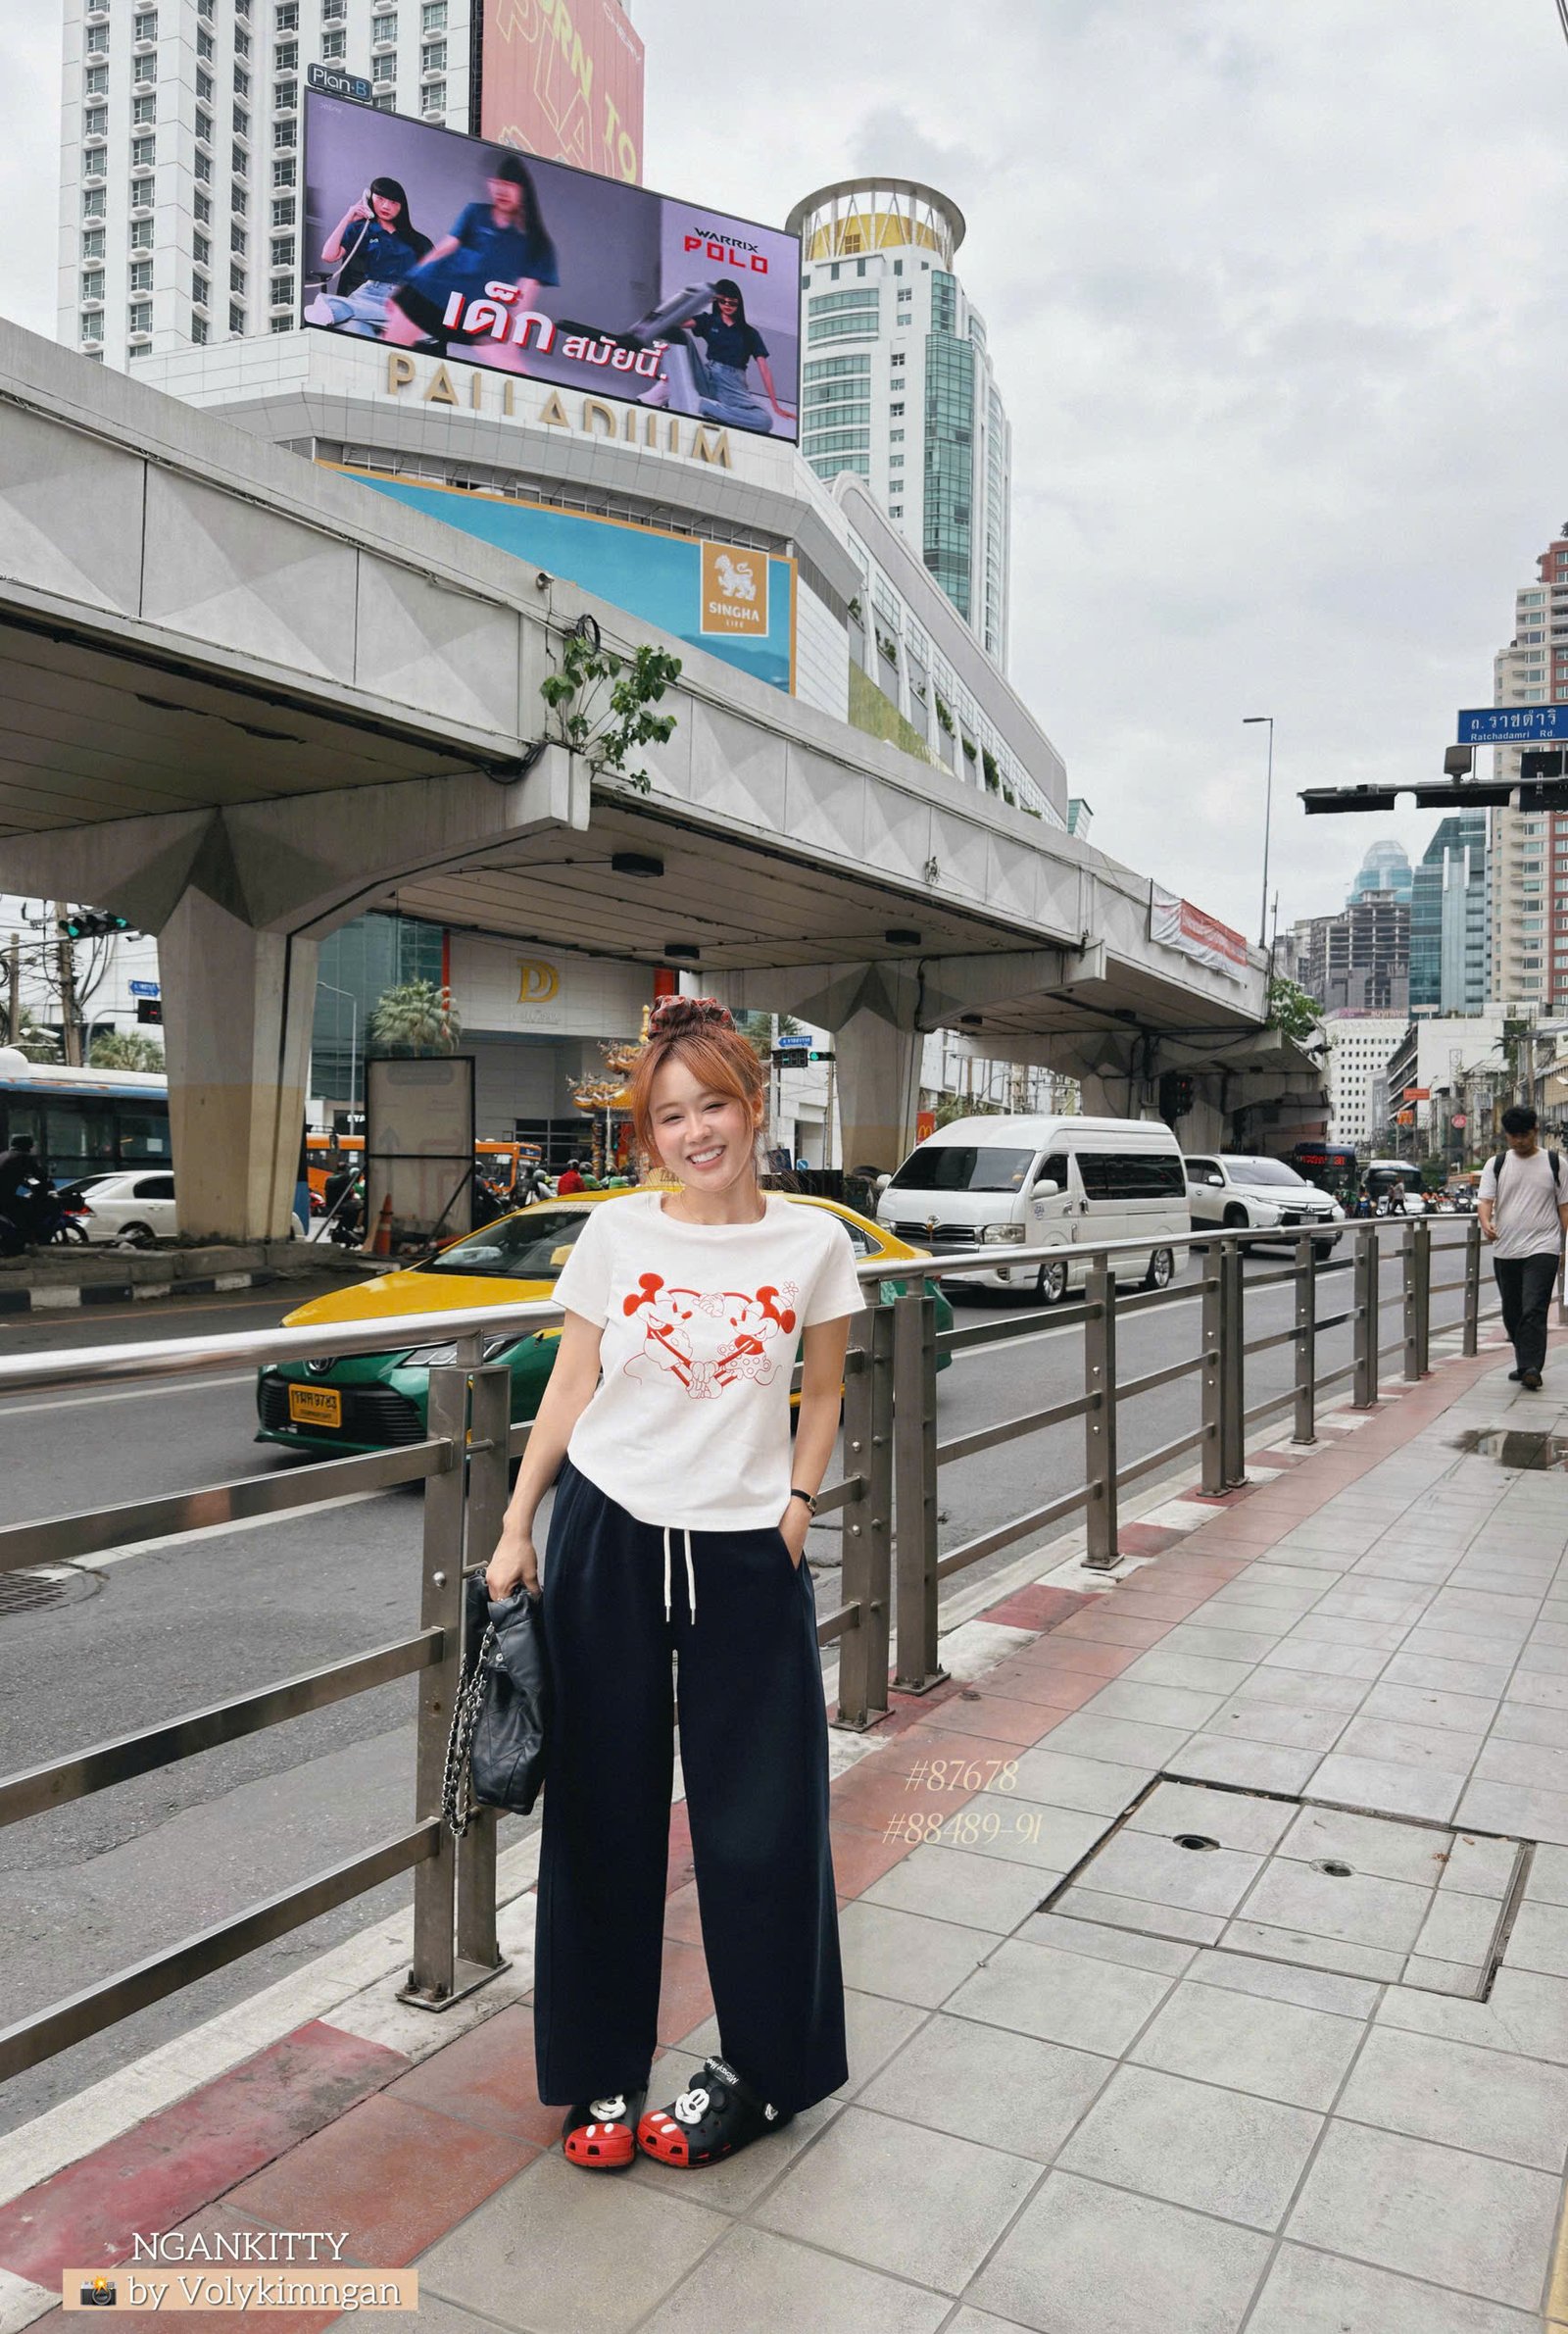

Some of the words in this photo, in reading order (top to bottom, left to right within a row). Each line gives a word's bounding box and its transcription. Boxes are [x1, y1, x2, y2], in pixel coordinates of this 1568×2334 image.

[693, 226, 759, 253] WARRIX
[684, 234, 768, 274] POLO
[442, 280, 557, 354] เด็ก
[709, 601, 760, 622] SINGHA
[1470, 731, 1530, 742] Ratchadamri
